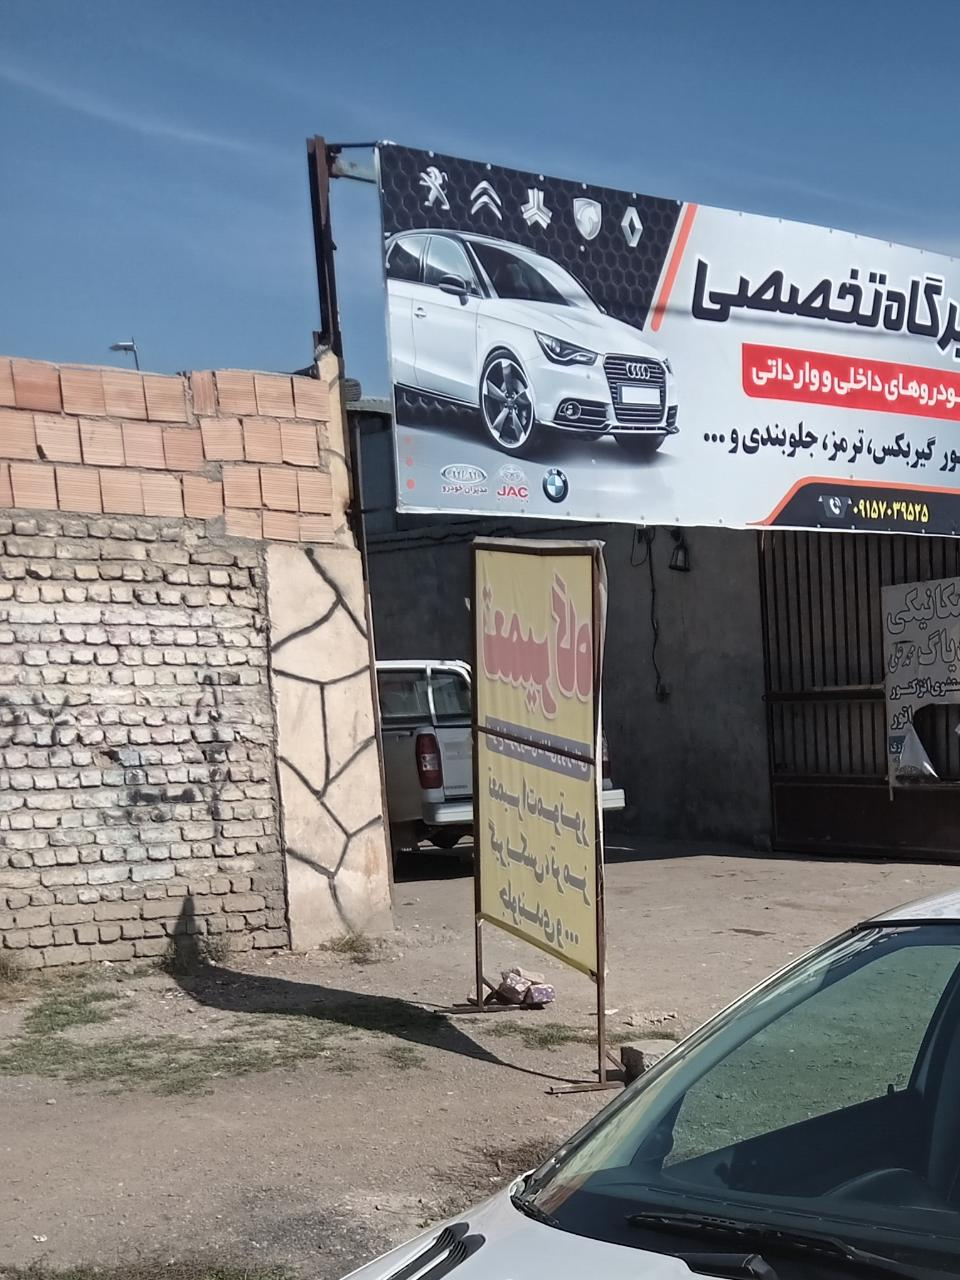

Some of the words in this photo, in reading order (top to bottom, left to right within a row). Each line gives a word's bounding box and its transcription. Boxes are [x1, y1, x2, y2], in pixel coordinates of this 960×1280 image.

[691, 257, 887, 328] تخصصی
[751, 358, 820, 392] وارداتی
[822, 370, 832, 393] و
[834, 366, 883, 395] داخلی
[728, 431, 739, 454] و
[741, 421, 818, 458] جلوبندی
[497, 486, 529, 498] JAC
